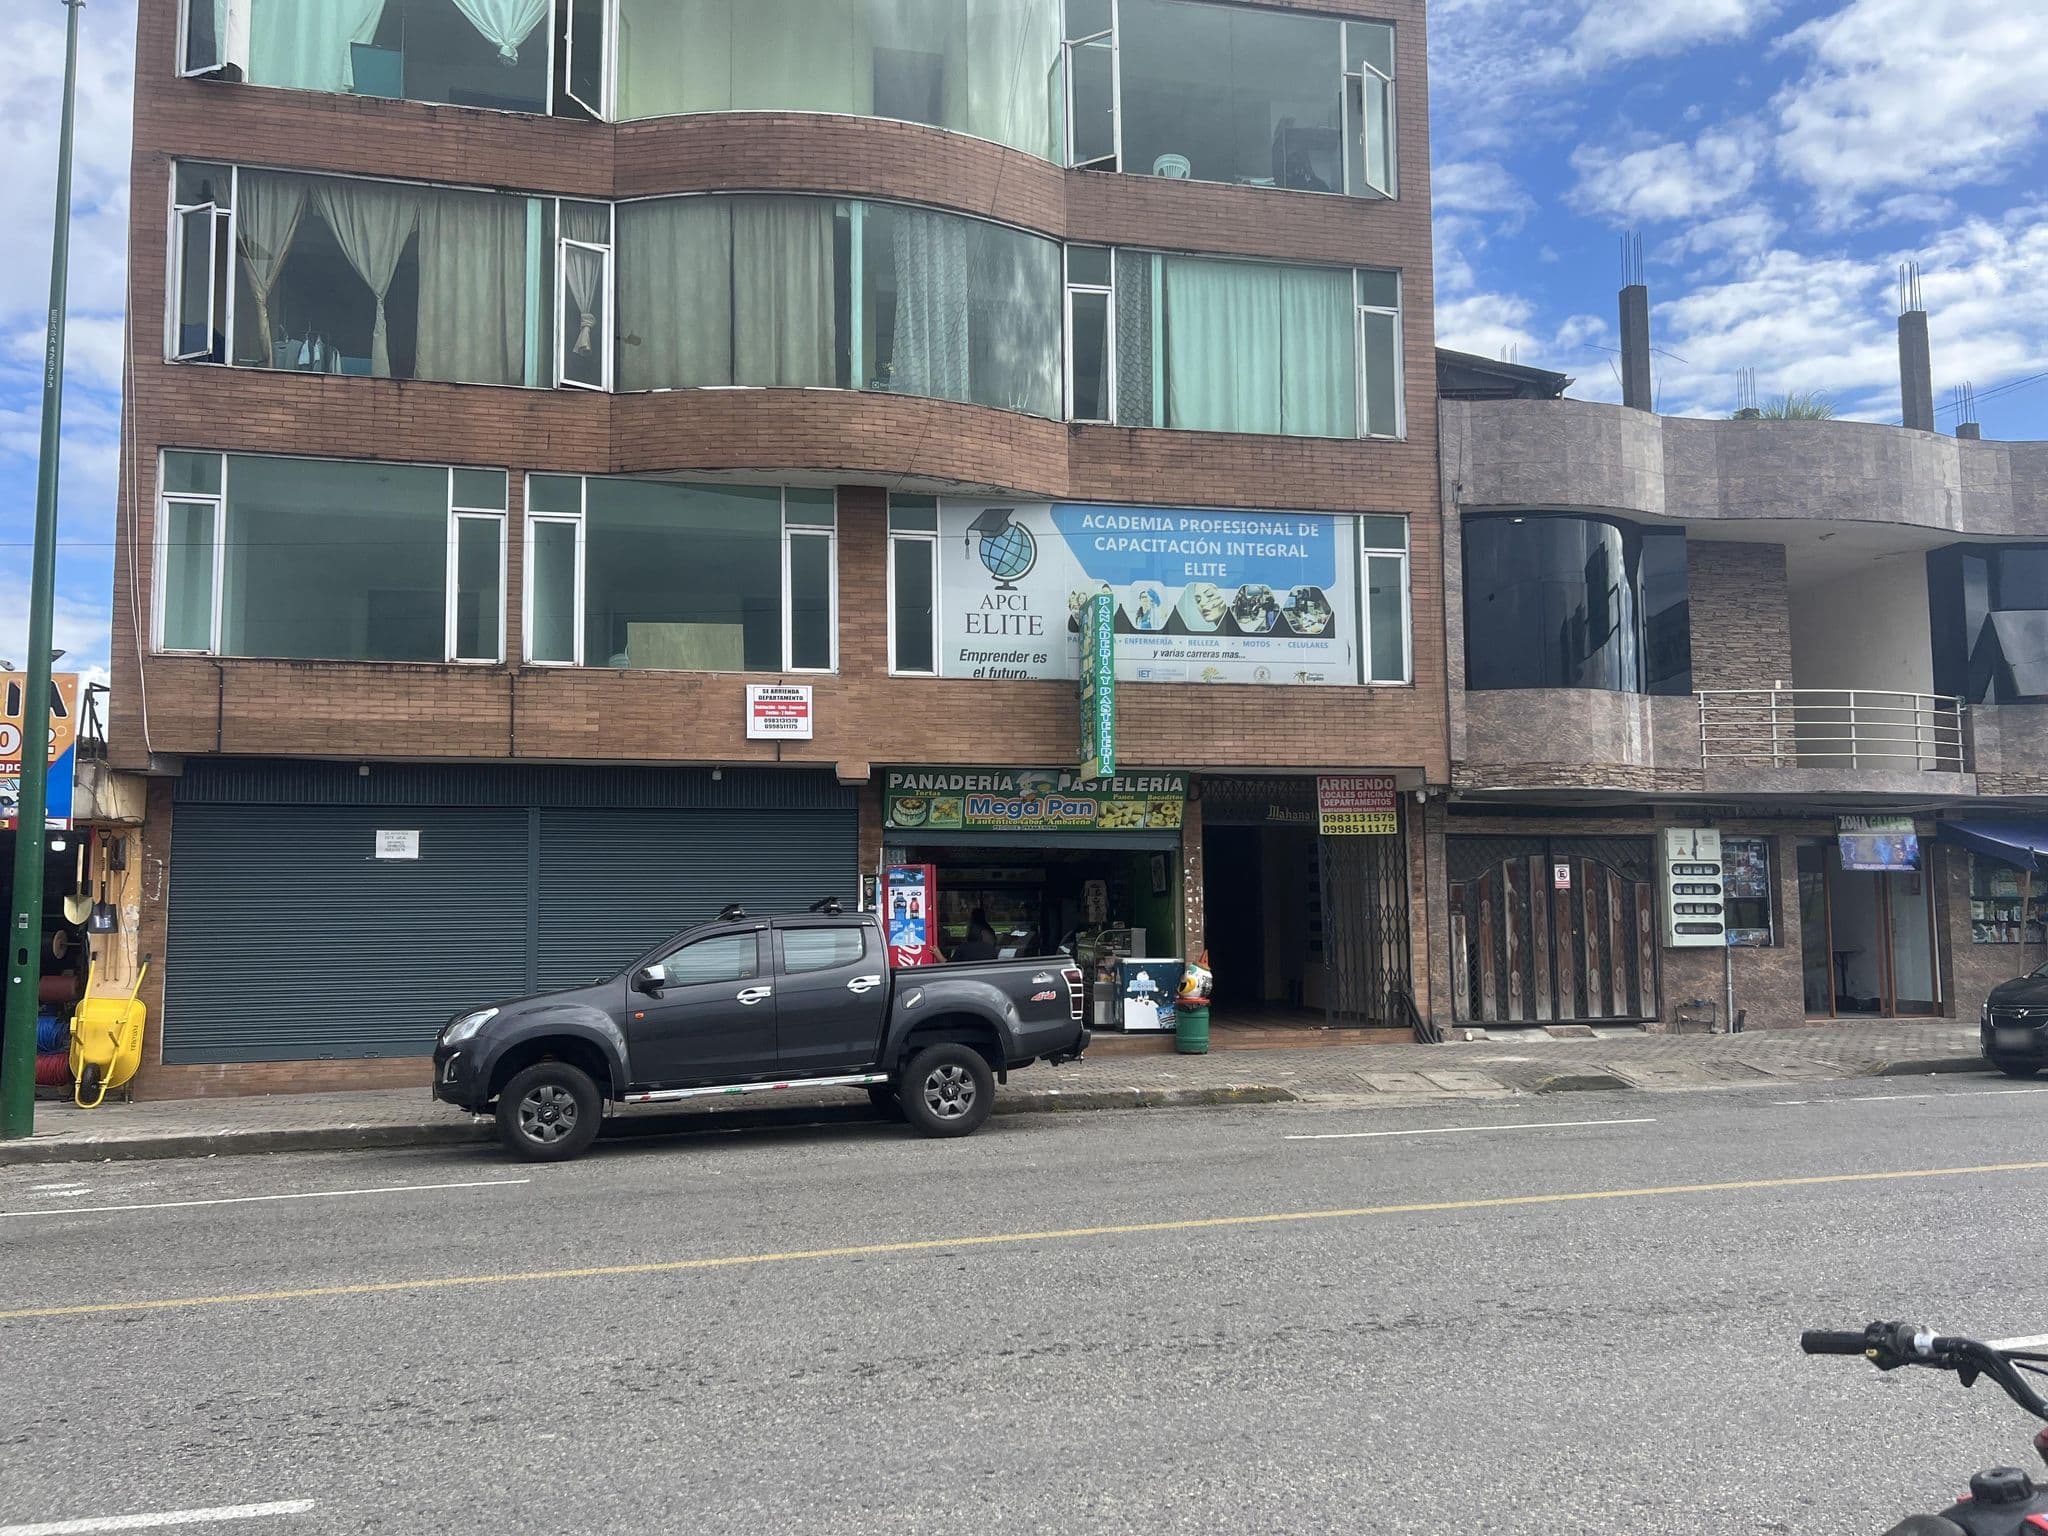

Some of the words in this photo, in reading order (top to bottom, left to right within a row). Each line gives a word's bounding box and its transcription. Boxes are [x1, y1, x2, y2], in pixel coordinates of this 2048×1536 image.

[1082, 514, 1174, 531] ACADEMIA
[1180, 518, 1293, 536] PROFESIONAL
[1299, 523, 1319, 537] DE
[1094, 537, 1221, 555] CAPACITACIÓN
[1226, 542, 1308, 558] INTEGRAL
[1184, 562, 1227, 577] ELITE
[980, 594, 1028, 611] APCI
[965, 613, 1044, 636] ELITE
[959, 649, 1030, 664] Emprender
[1032, 653, 1048, 663] es
[1153, 650, 1158, 659] y
[1186, 651, 1220, 659] carreras
[973, 667, 985, 679] el
[889, 771, 1013, 791] PANADERÍA
[1320, 778, 1394, 791] ARRIENDO
[1321, 791, 1356, 799] LOCALES
[1324, 798, 1392, 807] DEPARTAMENTOS
[968, 796, 1040, 819] Mega
[1047, 799, 1093, 816] Pan
[1322, 814, 1395, 822] 0983131579
[1323, 824, 1396, 833] 0998511175
